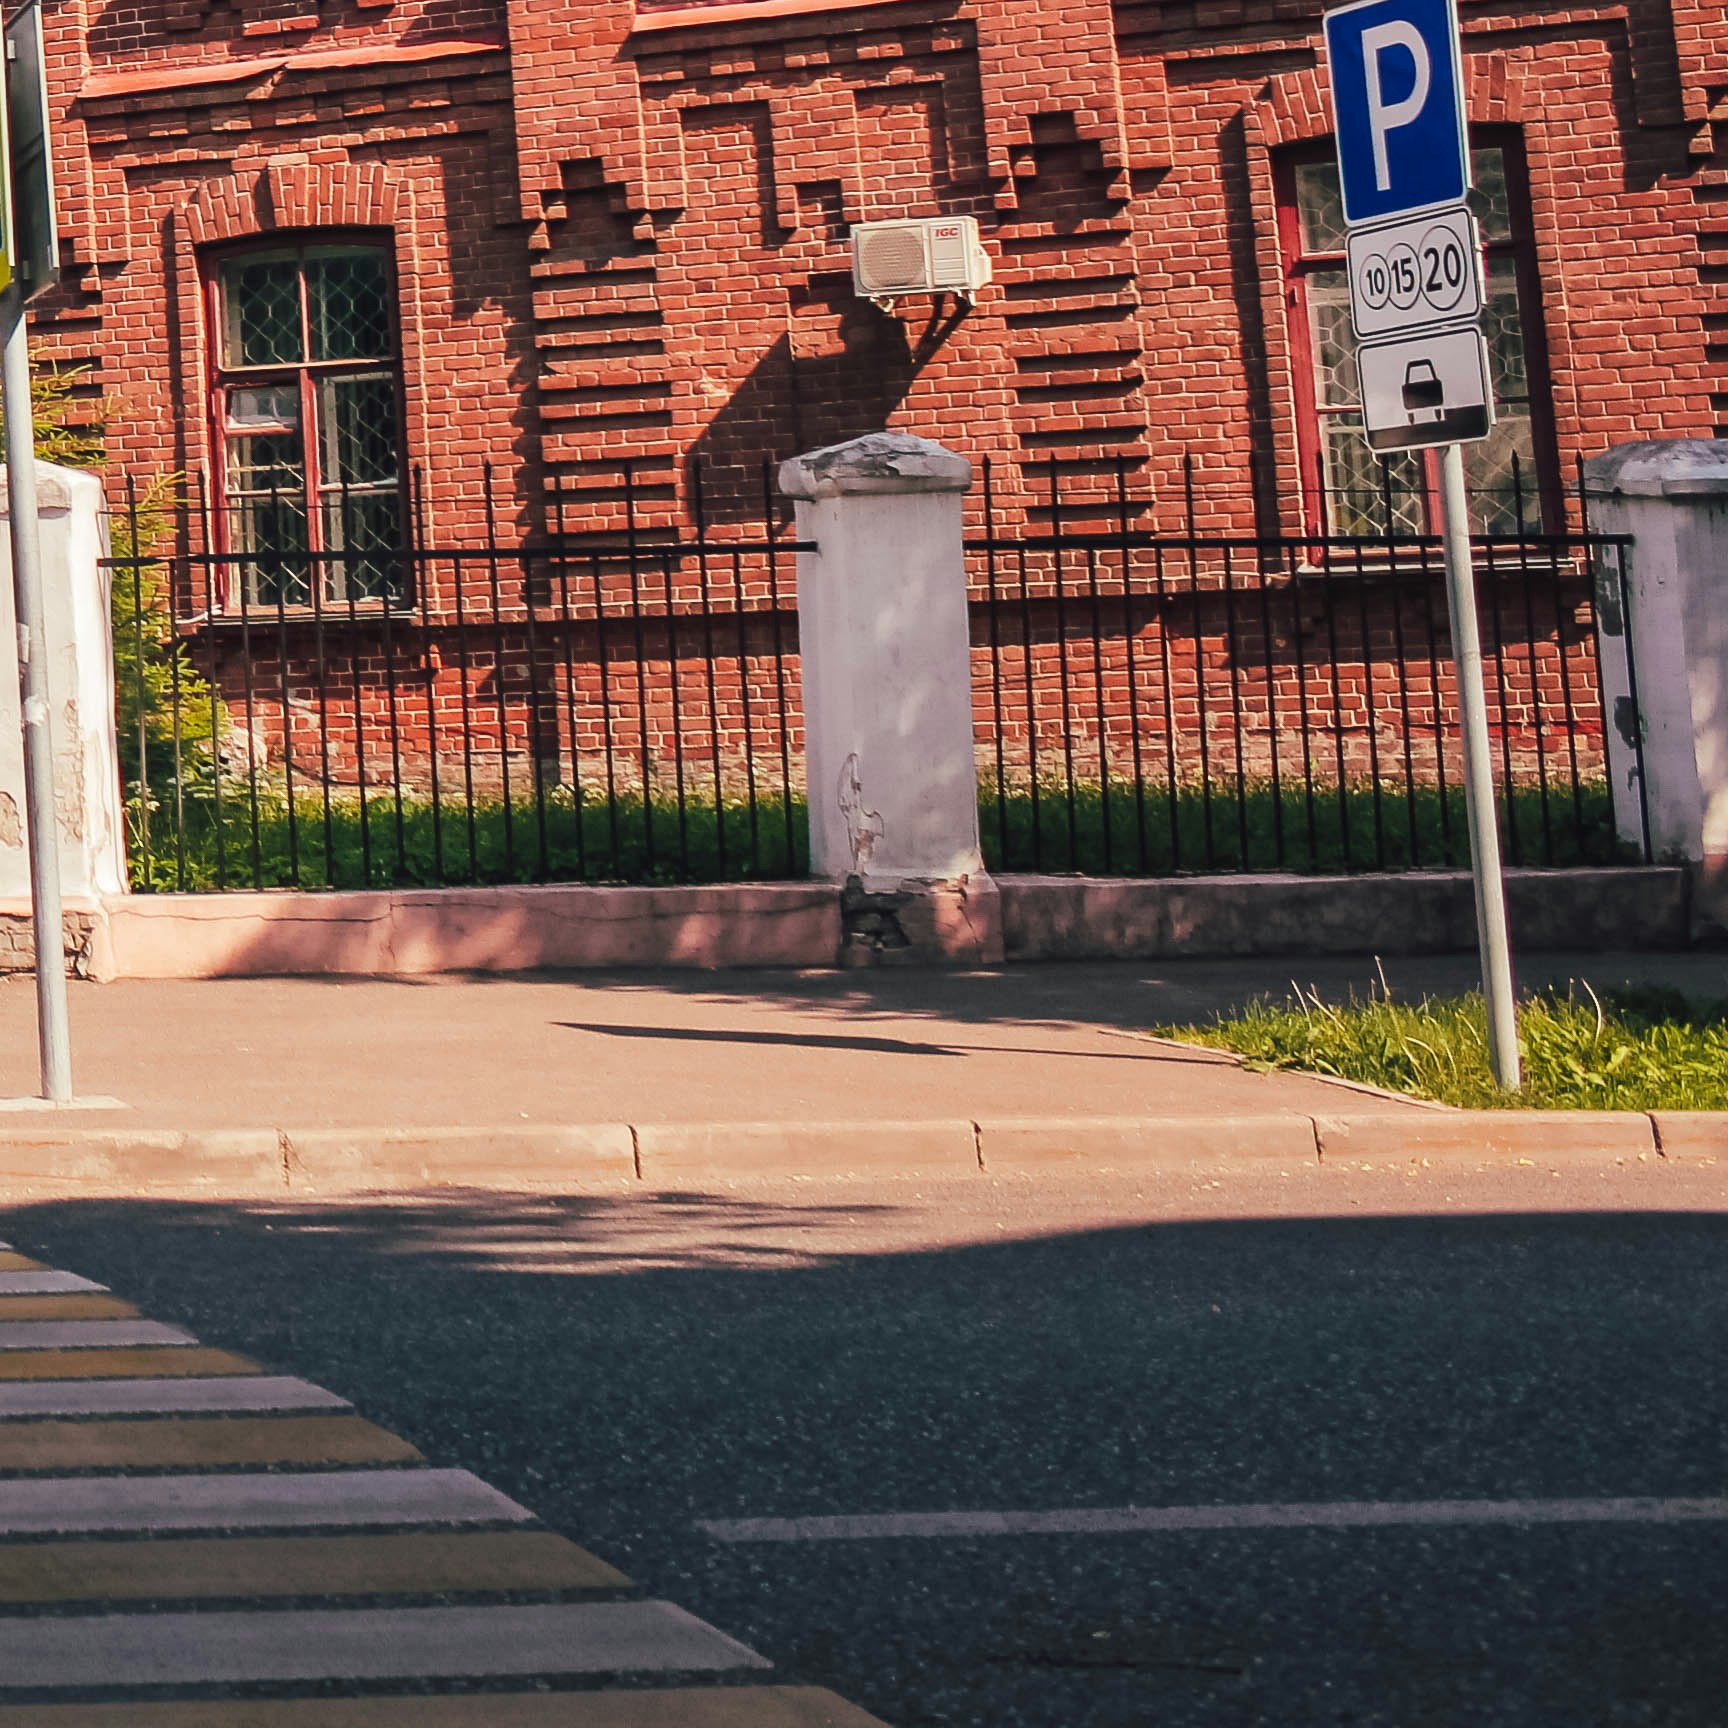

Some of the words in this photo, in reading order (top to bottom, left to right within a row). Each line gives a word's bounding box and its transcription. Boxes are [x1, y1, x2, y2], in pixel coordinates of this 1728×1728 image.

[1360, 19, 1431, 192] P
[935, 228, 958, 237] IGC
[1365, 267, 1385, 296] 10
[1391, 257, 1414, 294] 15
[1423, 243, 1461, 293] 20
